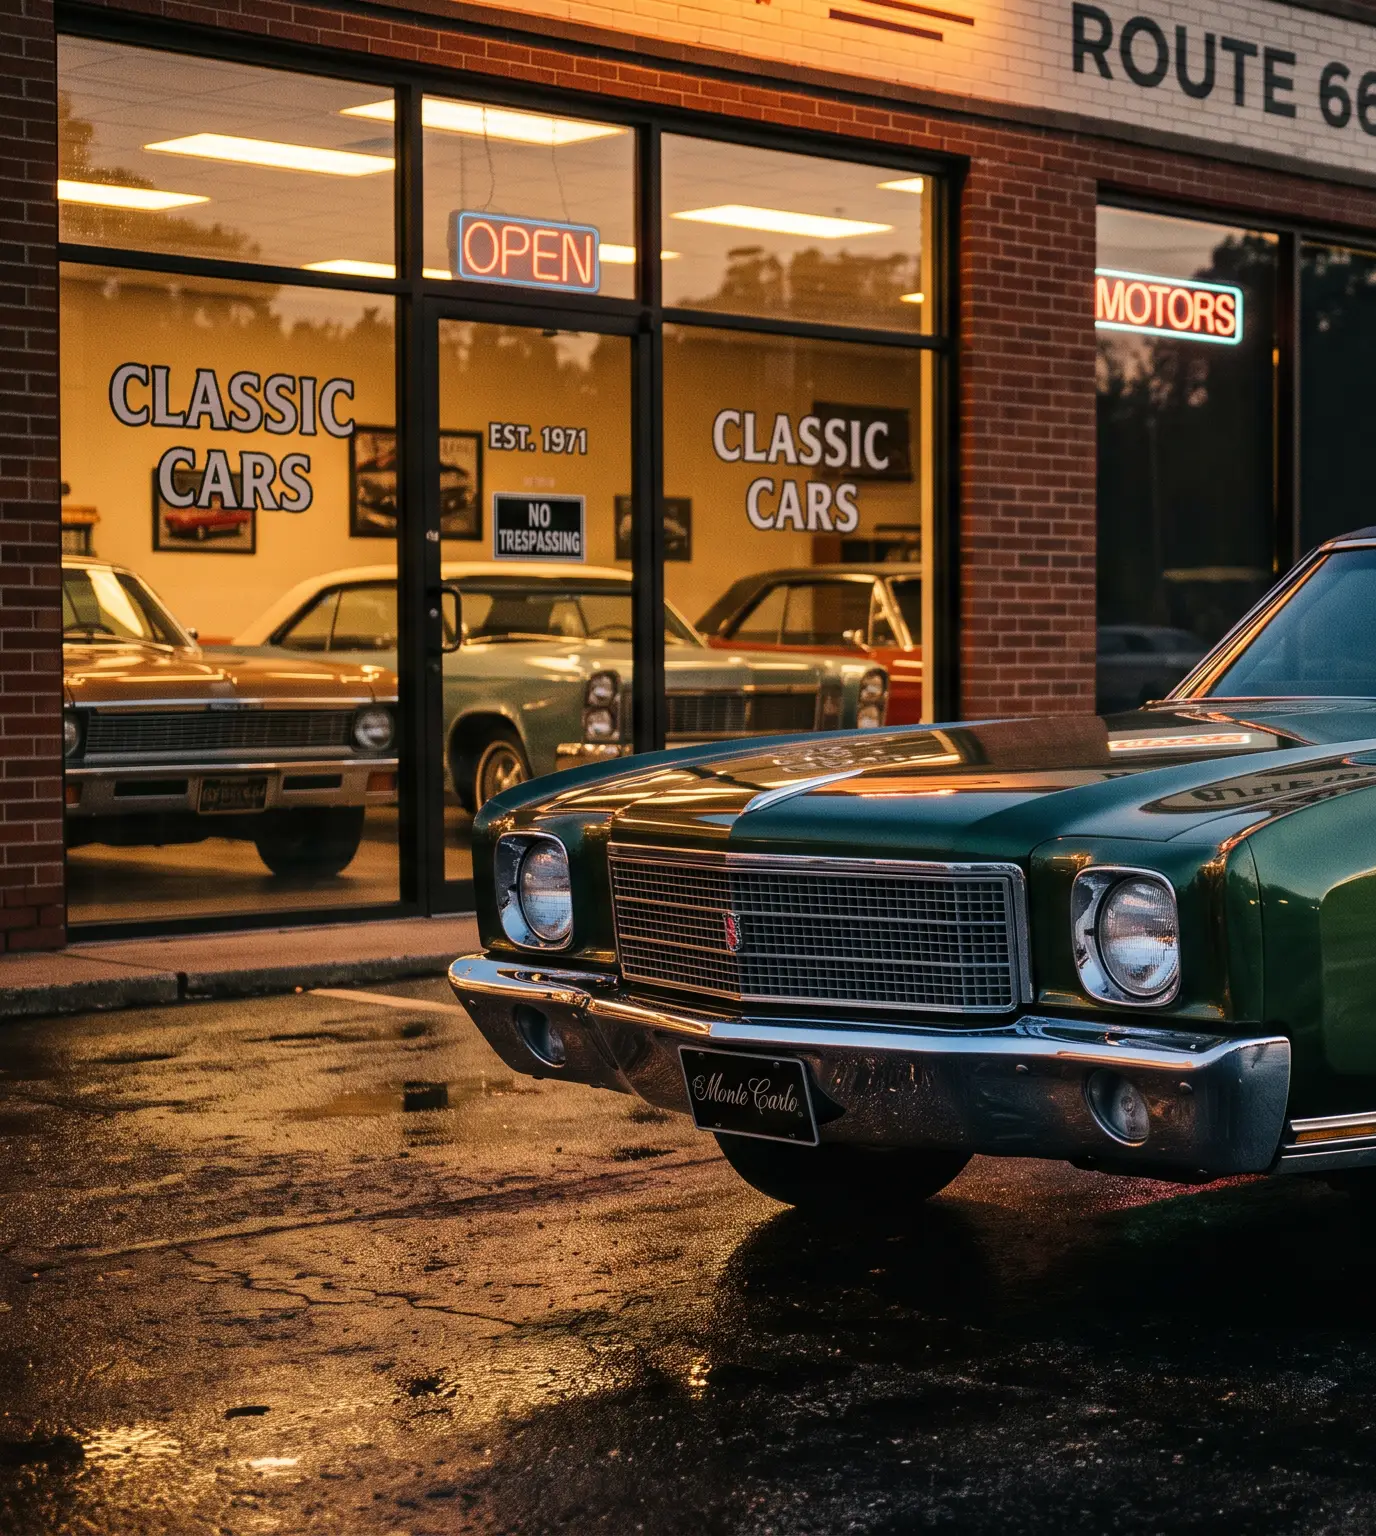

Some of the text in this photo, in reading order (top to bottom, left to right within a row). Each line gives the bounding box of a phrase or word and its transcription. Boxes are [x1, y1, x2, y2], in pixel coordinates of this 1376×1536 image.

[1072, 2, 1296, 118] ROUTE
[464, 221, 592, 284] OPEN
[1095, 277, 1236, 336] MOTORS
[109, 362, 355, 438] CLASSIC
[489, 422, 536, 452] EST.
[541, 426, 588, 455] 1971
[712, 408, 890, 470] CLASSIC
[157, 446, 313, 512] CARS
[746, 477, 859, 533] CARS
[499, 529, 580, 553] TRESPASSING
[528, 503, 552, 528] NO
[692, 1072, 800, 1115] Monte Carlo
